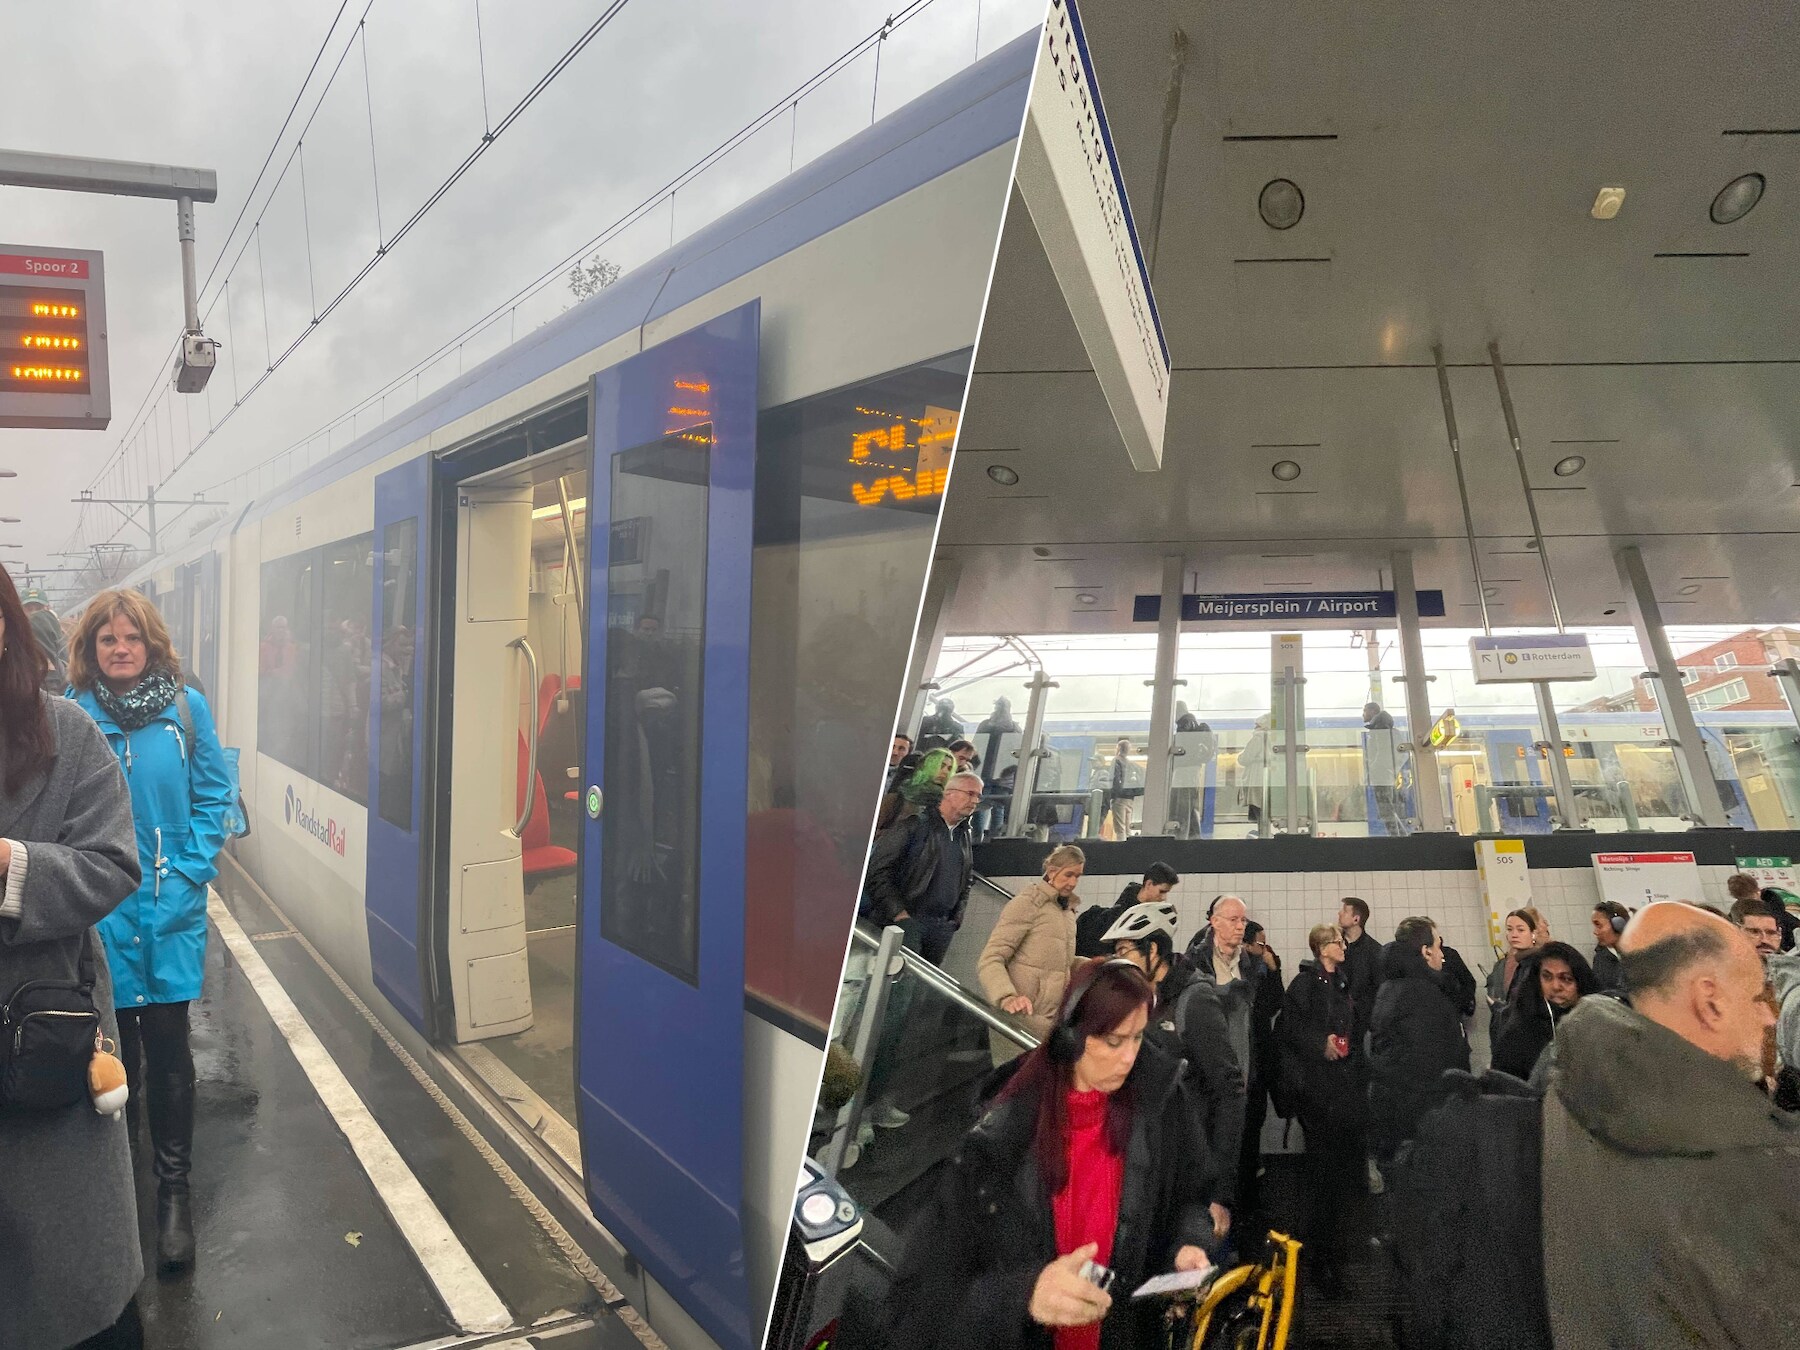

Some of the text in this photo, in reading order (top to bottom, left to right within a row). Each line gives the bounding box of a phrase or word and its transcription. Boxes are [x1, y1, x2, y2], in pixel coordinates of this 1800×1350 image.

[1076, 120, 1114, 242] Rotterdam
[25, 259, 79, 274] Spoor 2
[1198, 599, 1378, 617] Meijersplein / Airport
[1532, 652, 1581, 661] Rotterdam
[295, 797, 346, 858] RandstadRail
[1496, 856, 1514, 864] SOS
[1756, 858, 1774, 866] AED
